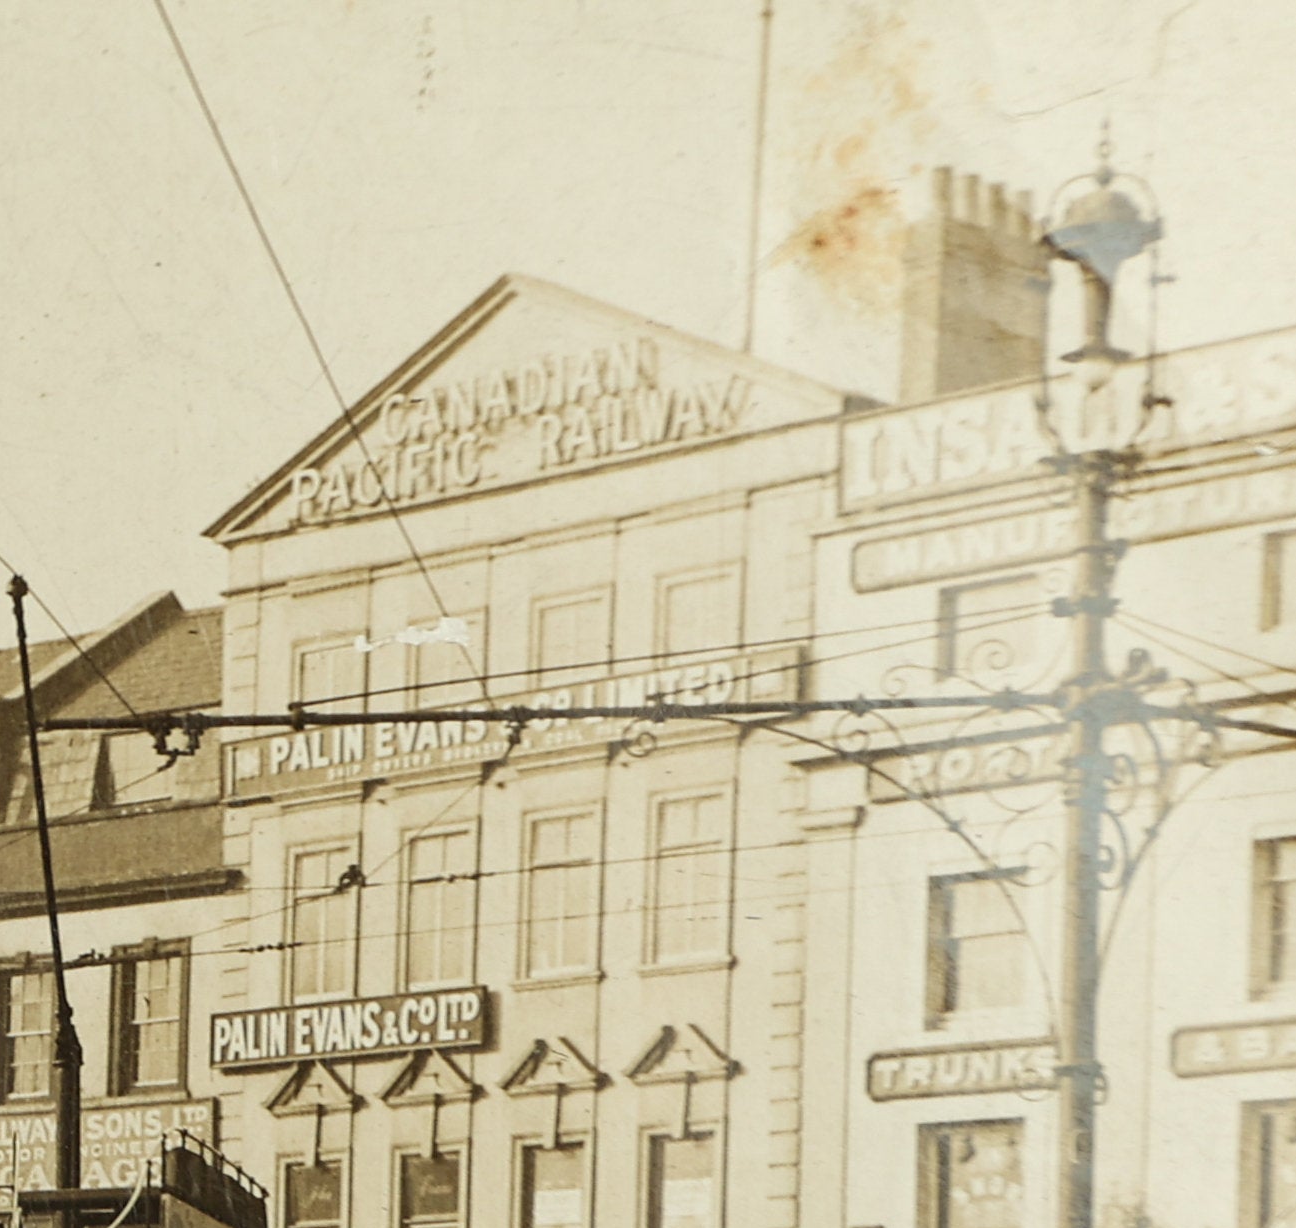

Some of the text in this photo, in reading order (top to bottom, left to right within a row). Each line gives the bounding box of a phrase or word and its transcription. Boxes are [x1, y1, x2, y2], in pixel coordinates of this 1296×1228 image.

[378, 336, 657, 444] CANADIAN
[290, 376, 749, 517] PACIFIC RAILWAY
[269, 726, 364, 774] PALIN
[375, 708, 488, 758] EVANS
[214, 1018, 288, 1063] PALIN
[294, 1005, 381, 1054] EVANS
[383, 1014, 401, 1046] &
[874, 1048, 1059, 1090] TRUNKS
[86, 1109, 162, 1140] SONS
